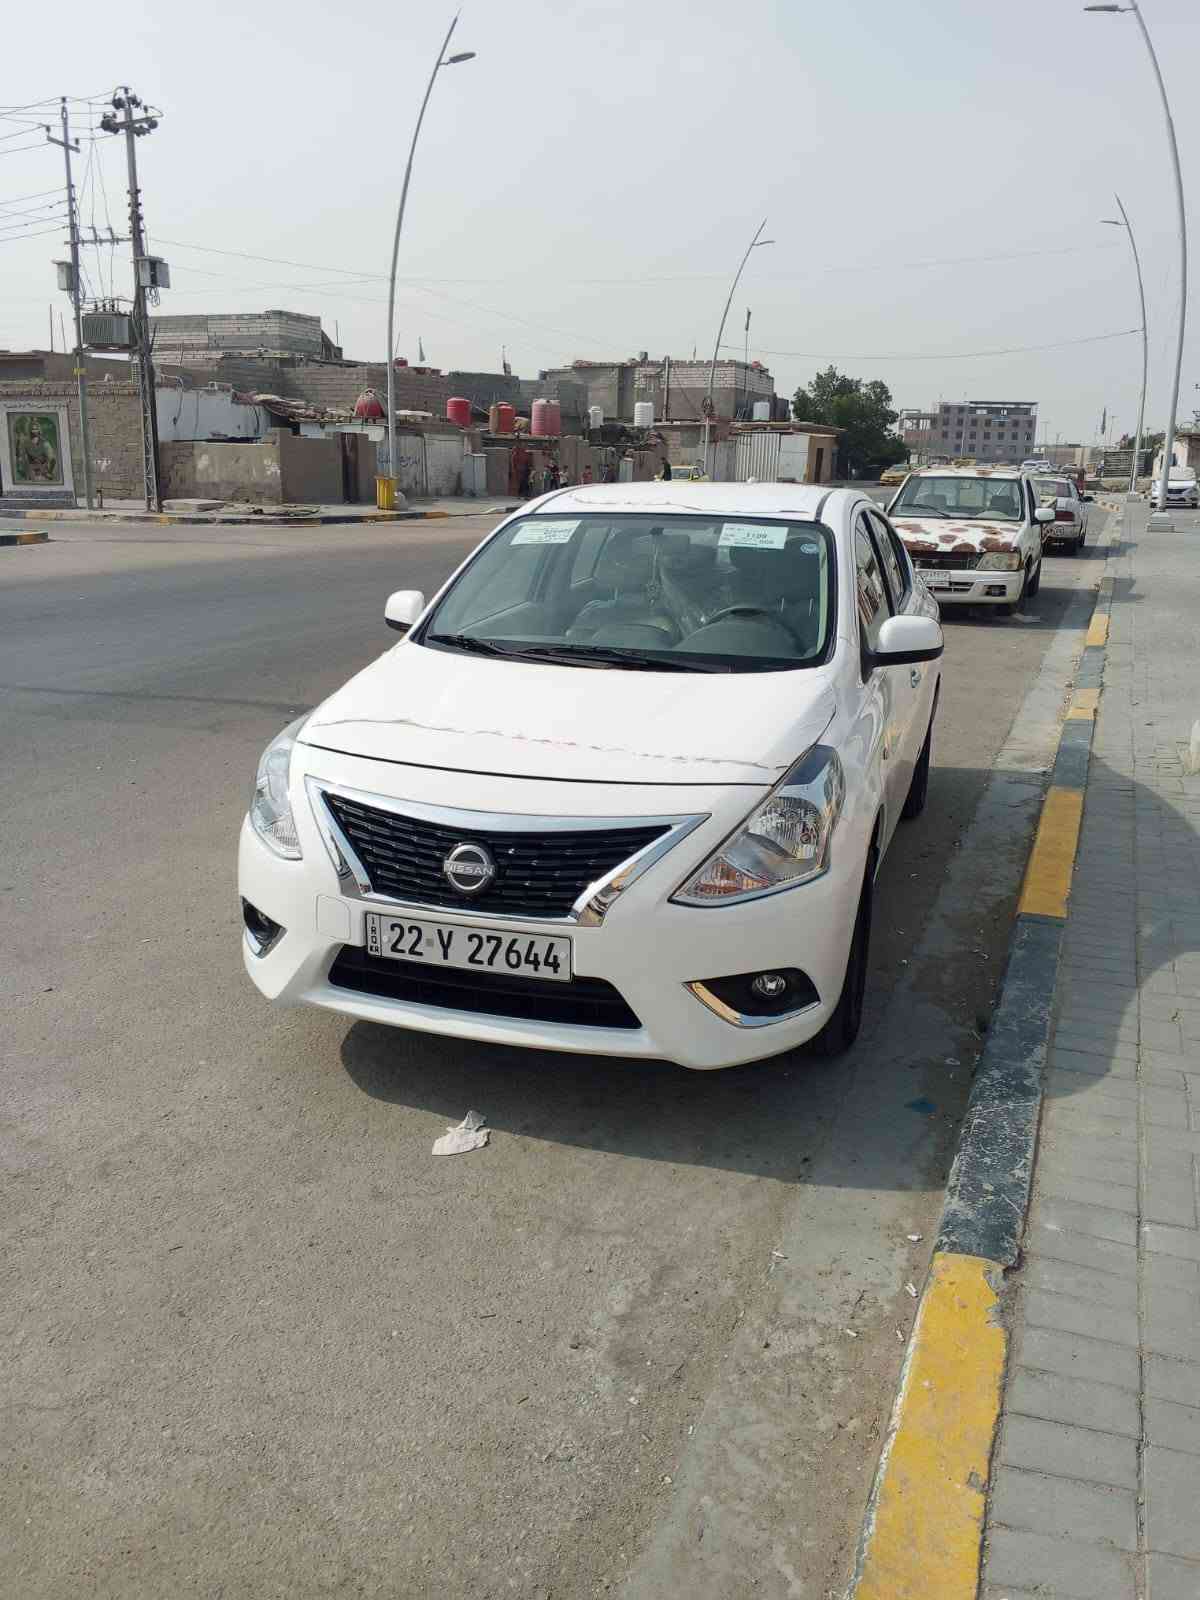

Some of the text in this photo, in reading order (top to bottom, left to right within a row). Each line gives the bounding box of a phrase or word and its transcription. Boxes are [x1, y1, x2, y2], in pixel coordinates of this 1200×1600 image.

[444, 862, 494, 877] NISSAN
[390, 922, 560, 974] 22 Y 27644
